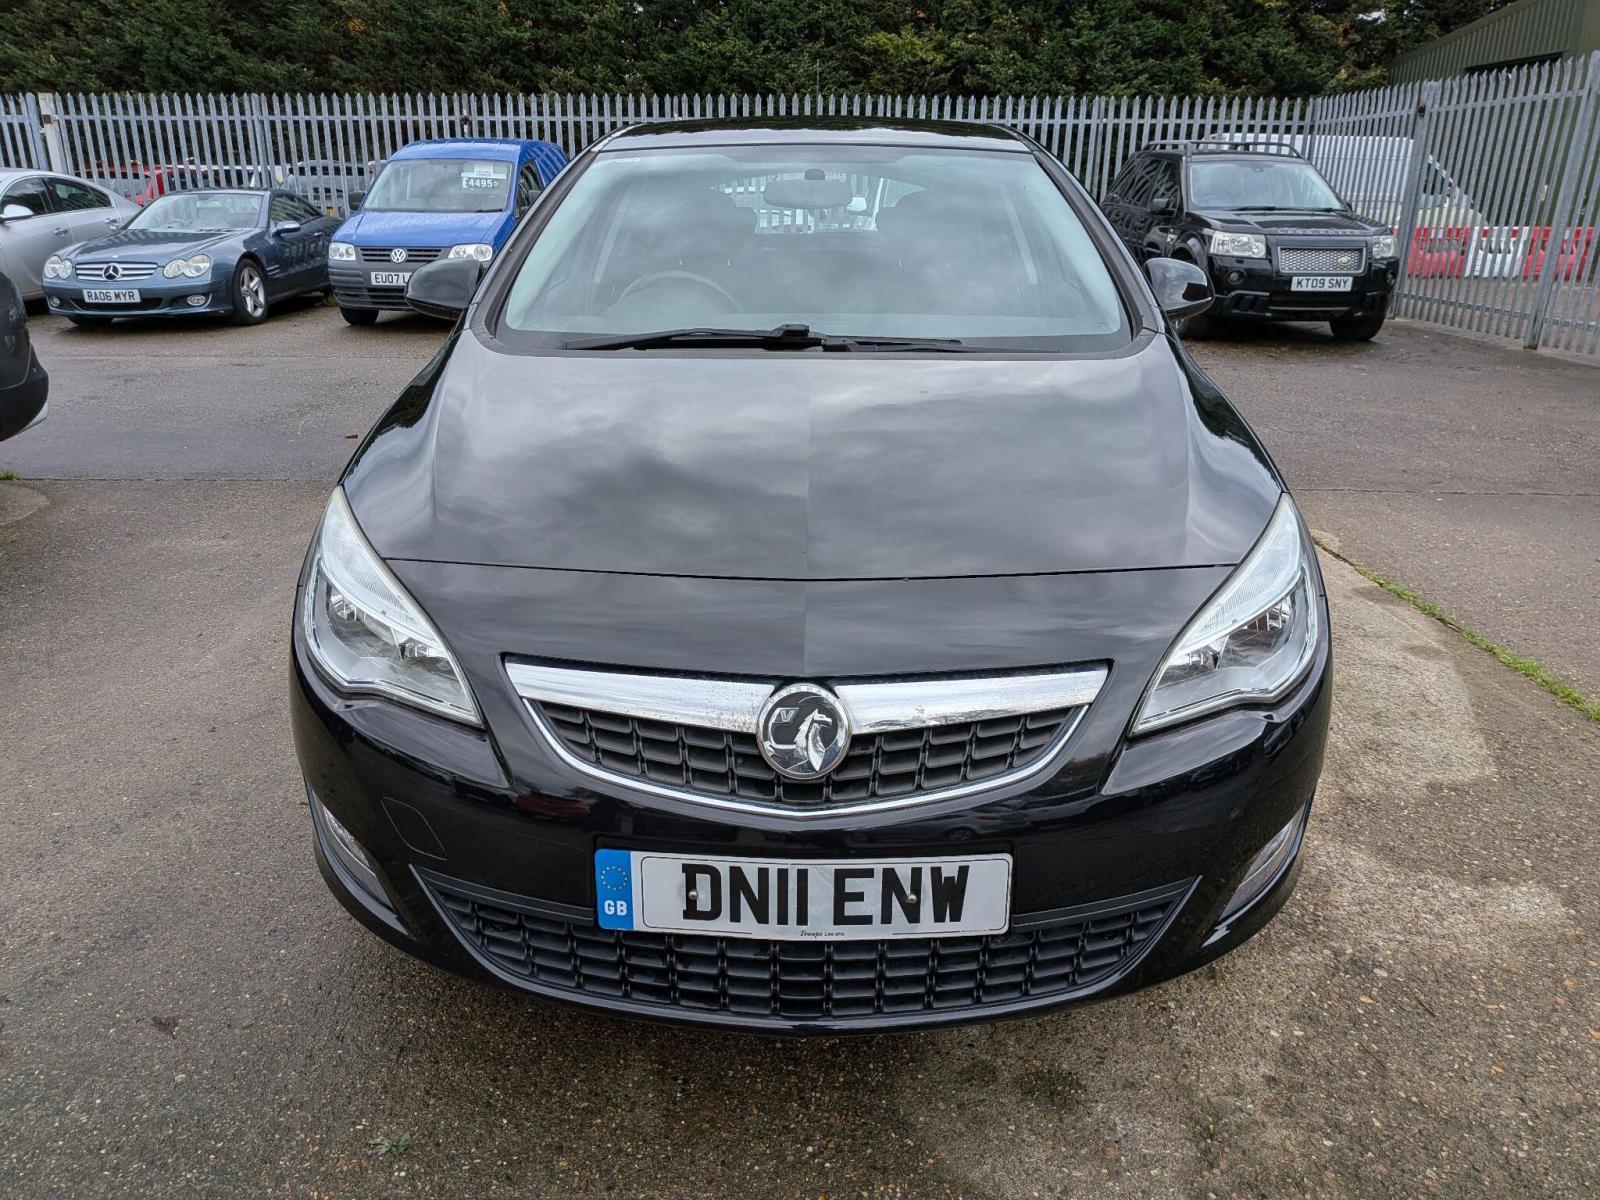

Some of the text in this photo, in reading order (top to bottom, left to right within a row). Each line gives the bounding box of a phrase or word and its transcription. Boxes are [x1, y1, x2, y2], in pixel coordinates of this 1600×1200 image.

[374, 273, 400, 284] EU07
[1296, 278, 1349, 289] KT09 SNY
[87, 290, 135, 301] RA06 MYR
[681, 863, 970, 926] DN11 ENW
[604, 899, 628, 917] GB
[800, 930, 823, 939] Troops
